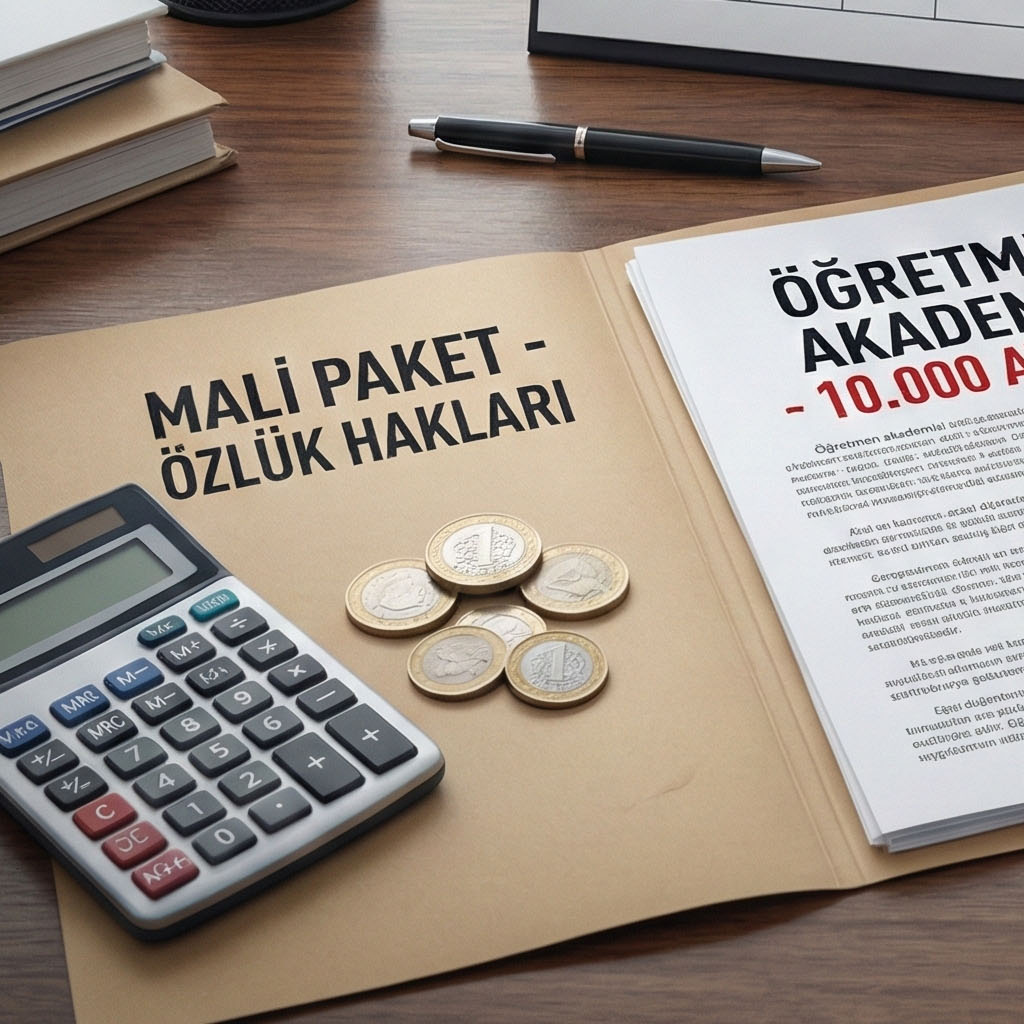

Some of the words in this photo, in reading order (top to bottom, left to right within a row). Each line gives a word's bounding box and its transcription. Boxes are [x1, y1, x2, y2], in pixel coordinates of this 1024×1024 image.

[144, 355, 300, 440] MALİ
[311, 325, 502, 408] PAKET
[816, 354, 991, 419] 10.000
[160, 425, 336, 501] ÖZLÜK
[341, 379, 577, 466] HAKLARI
[233, 690, 252, 706] 9
[88, 714, 126, 740] MRC
[180, 718, 201, 733] 8
[262, 715, 282, 731] 6
[124, 744, 141, 762] 7
[208, 742, 230, 759] 5
[158, 773, 176, 789] 4
[239, 771, 263, 789] 2
[95, 804, 116, 820] C
[186, 802, 204, 816] 1
[213, 828, 236, 845] 0
